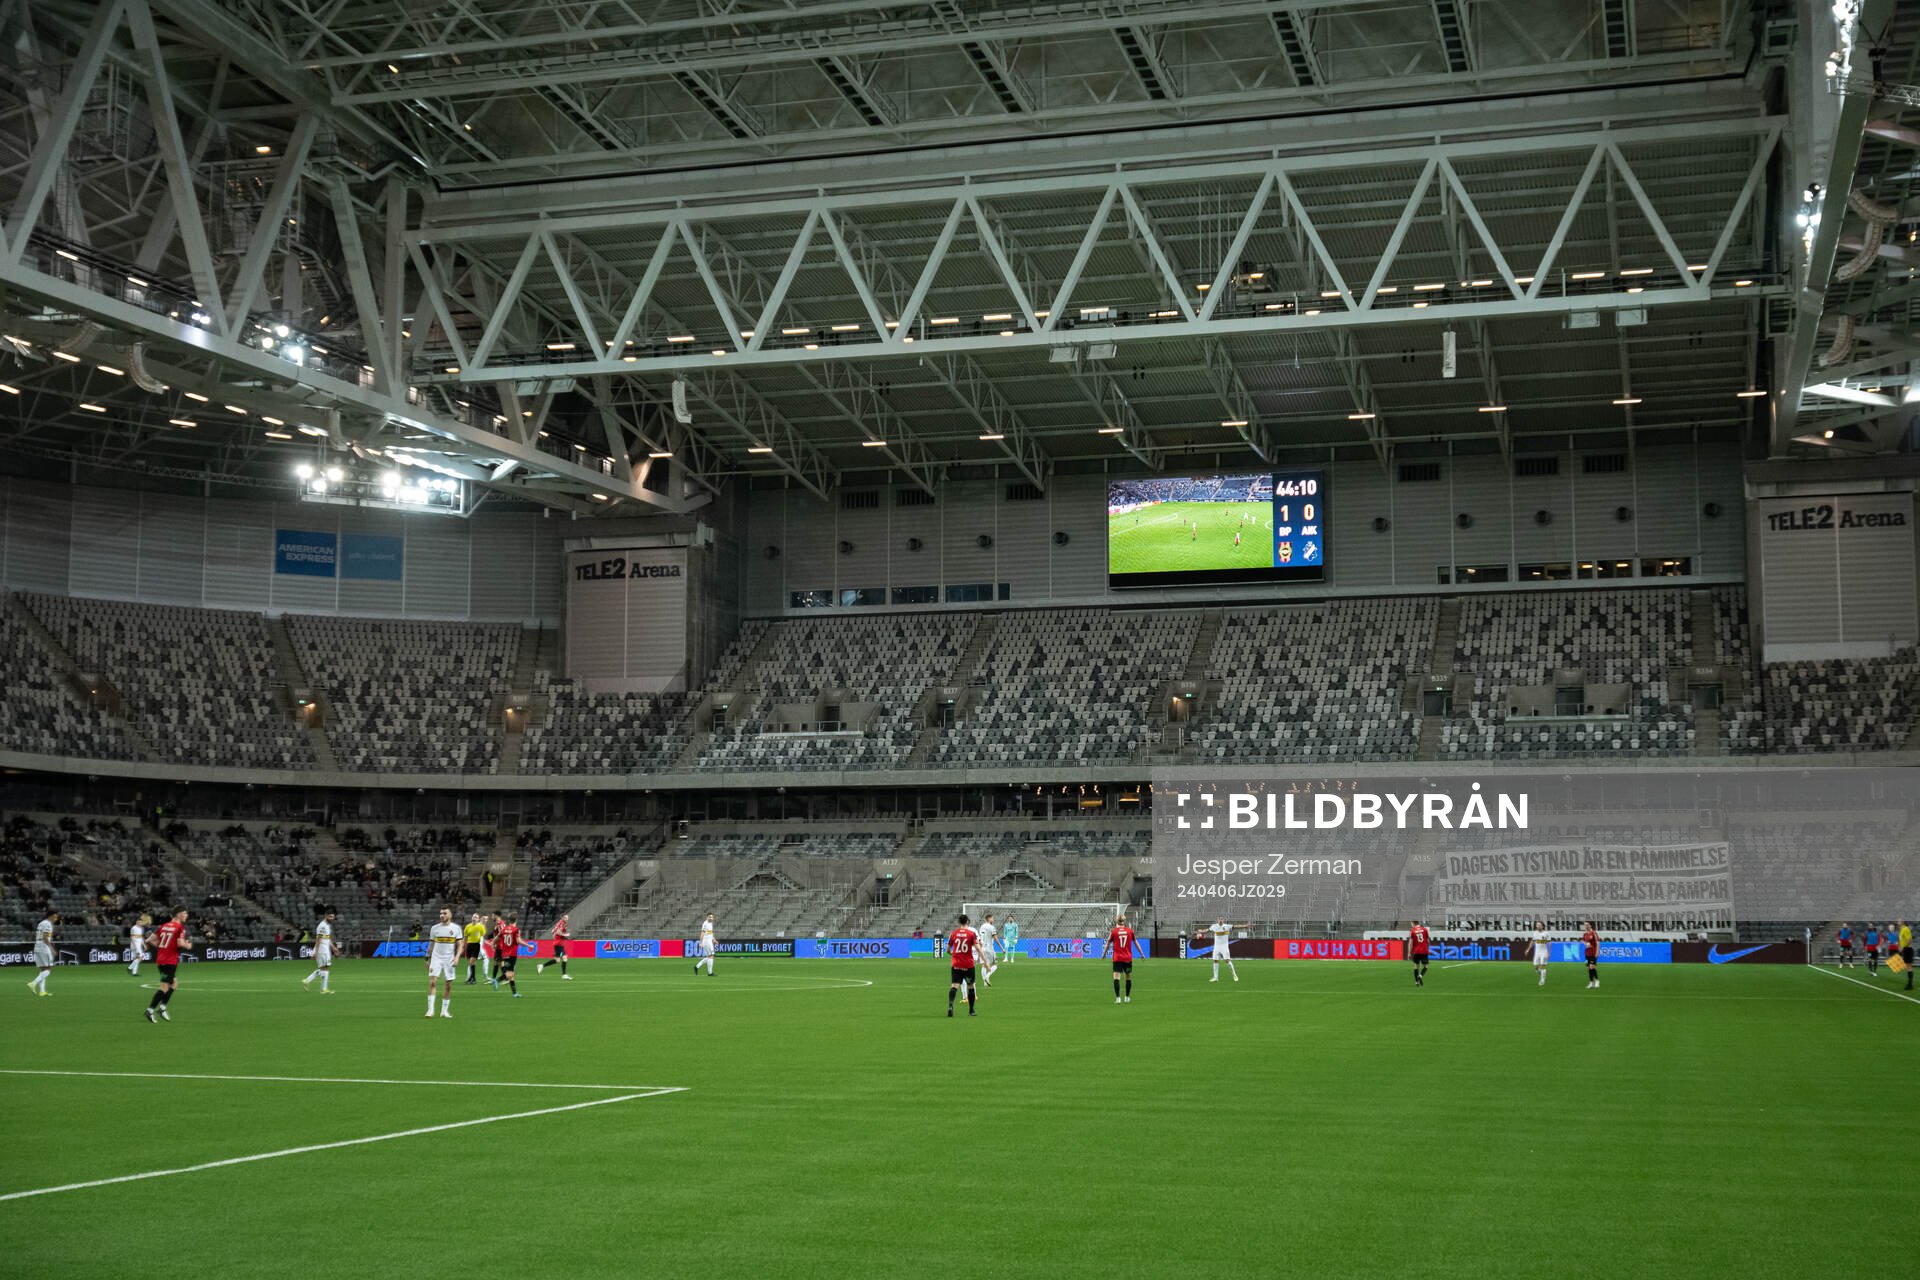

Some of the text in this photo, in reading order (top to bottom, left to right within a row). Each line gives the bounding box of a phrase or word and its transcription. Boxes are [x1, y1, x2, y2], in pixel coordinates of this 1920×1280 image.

[1276, 480, 1317, 496] 44:10
[1281, 504, 1314, 521] 1 0
[1768, 505, 1906, 530] TELE2 Arena
[1279, 526, 1317, 536] BP AIK
[279, 544, 335, 555] AMERICAN
[286, 553, 334, 563] EXPRESS
[575, 558, 681, 580] TELE2 Arena
[1450, 847, 1727, 876] DAGENS TYSTNAD ÄR EN PÅMINNELSE
[1445, 877, 1728, 902] FRÅN AIK TILL ALLA UPPBLÅSTA PAMPAR
[159, 932, 172, 949] 27
[504, 934, 513, 946] 10
[614, 940, 653, 952] weber
[955, 938, 968, 953] 26
[1119, 935, 1127, 948] 17
[206, 947, 265, 960] En tryggare vård
[714, 943, 742, 952] SKIVOR
[745, 943, 760, 952] TILL
[762, 943, 792, 952] BYGGET
[831, 942, 890, 954] TEKNOS
[1288, 943, 1388, 956] BAUHAUS
[1428, 943, 1511, 960] stadium
[97, 951, 117, 962] Heba
